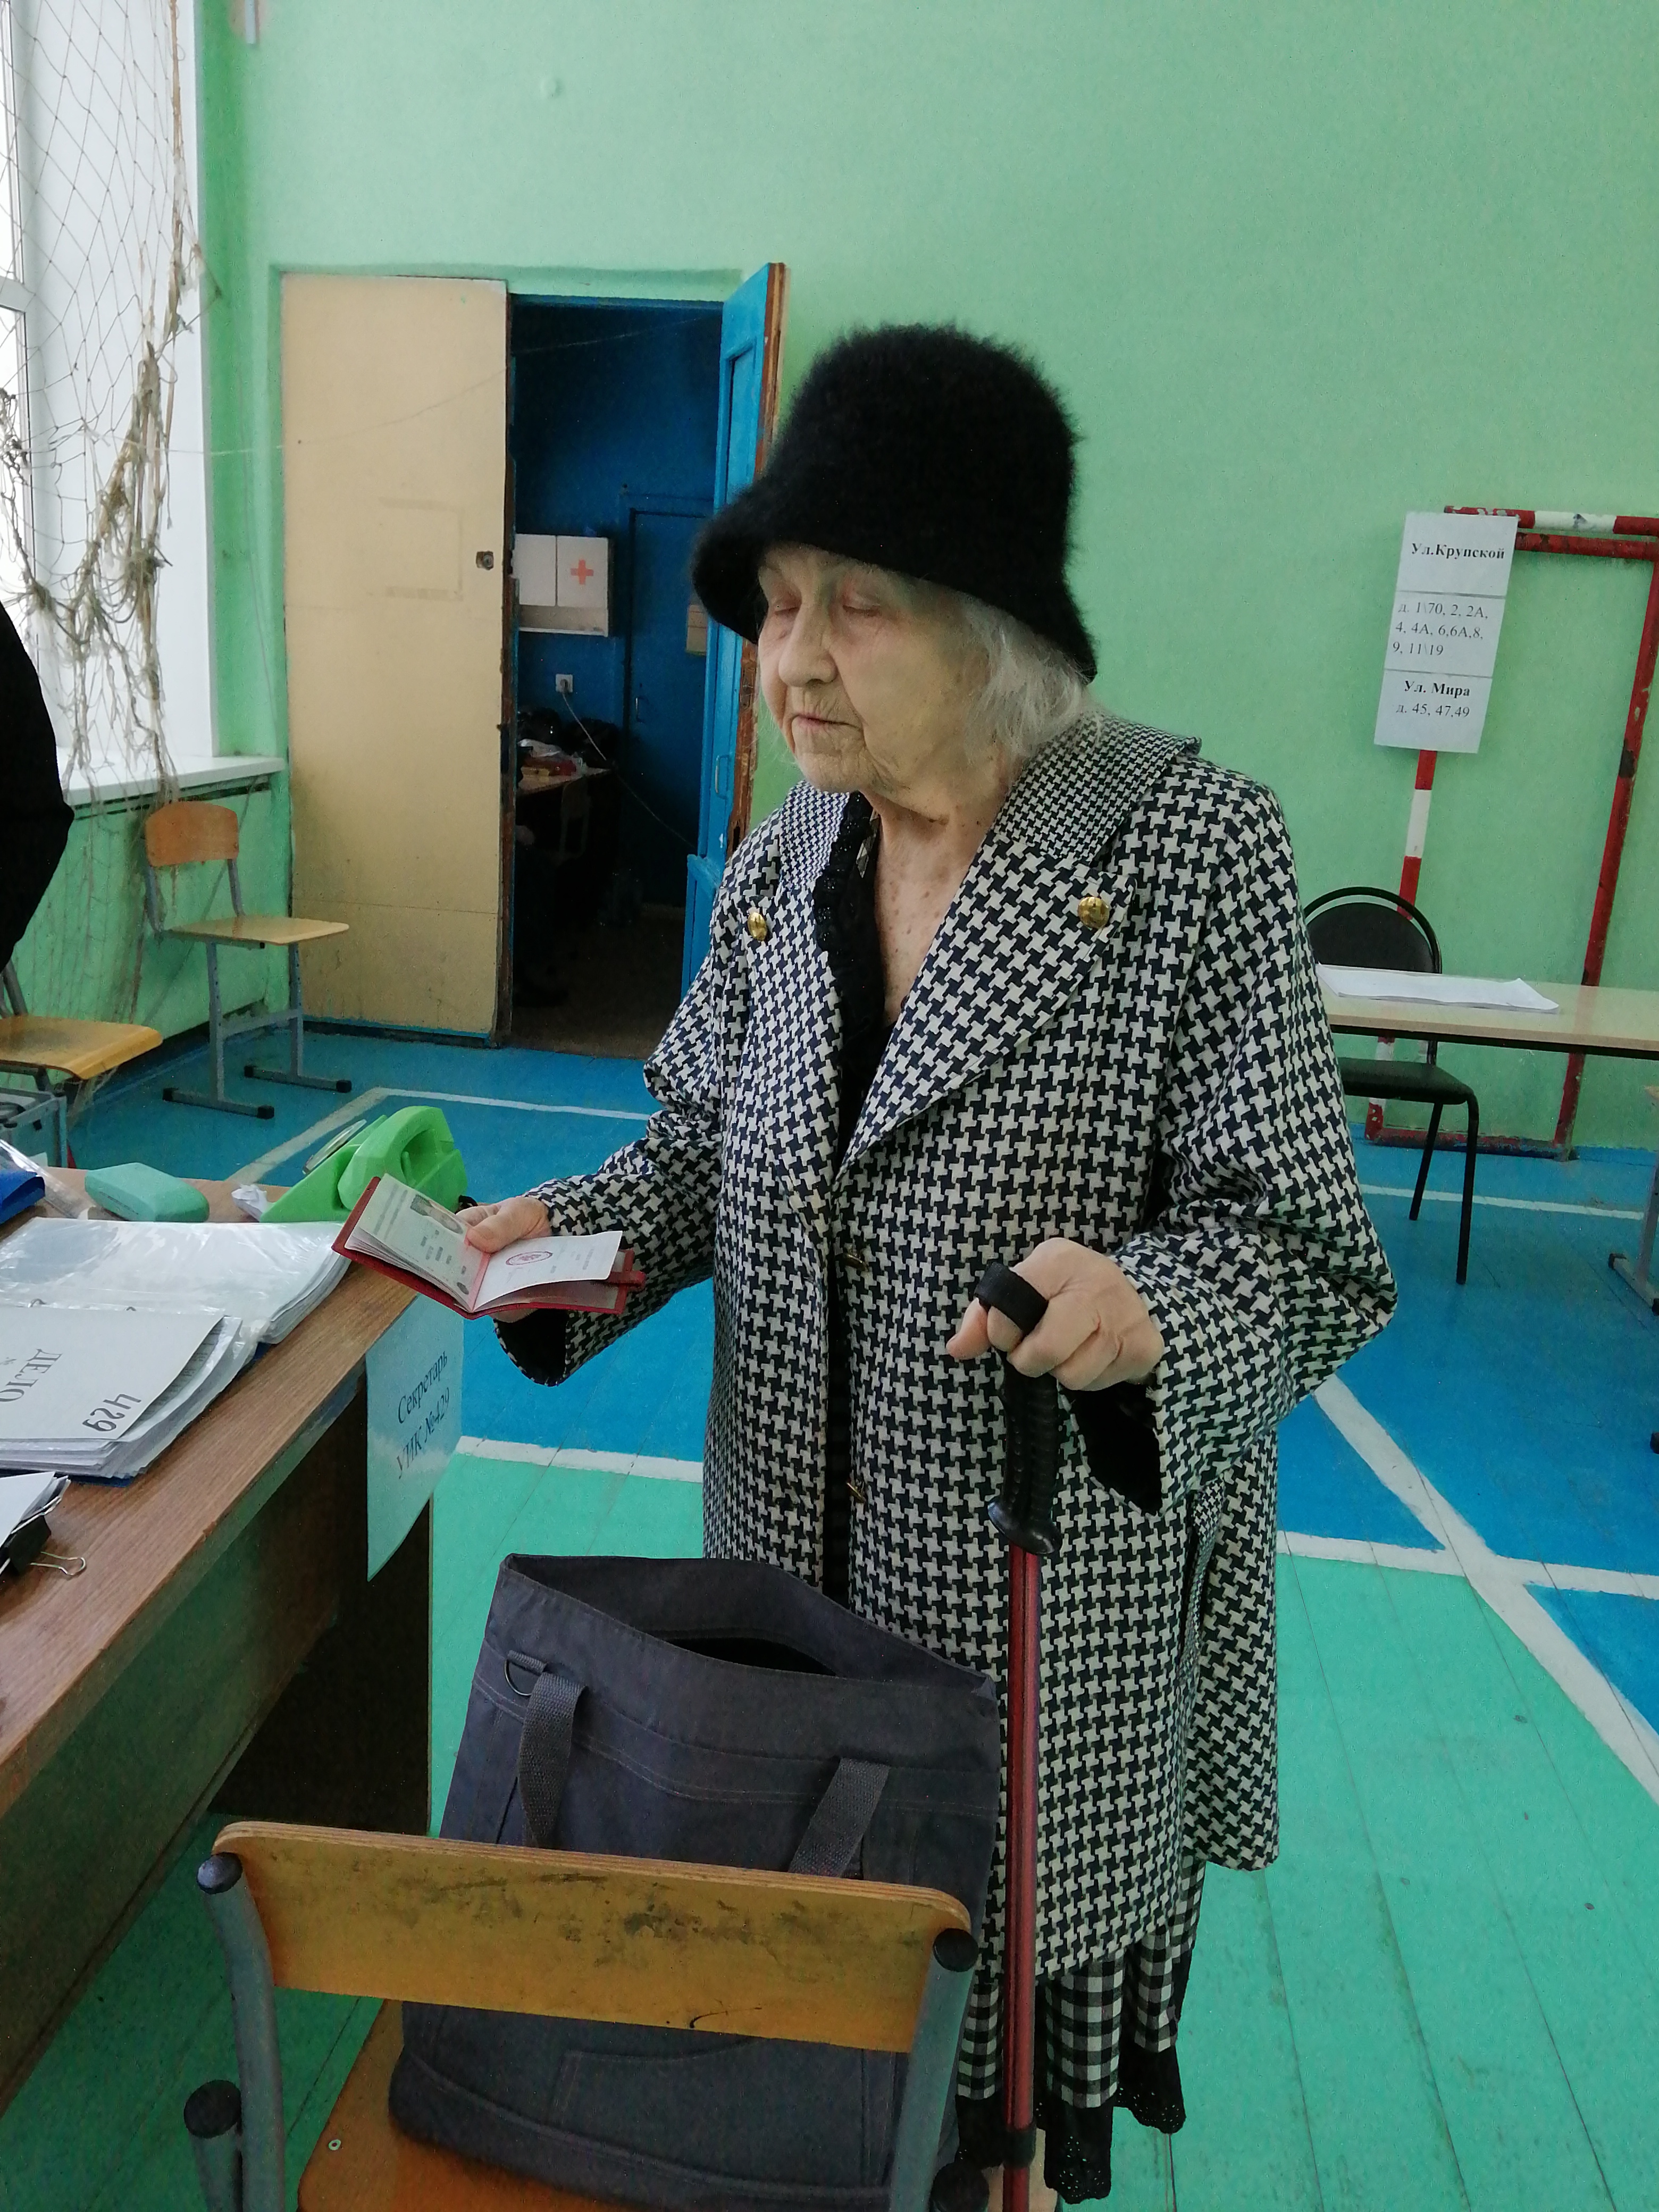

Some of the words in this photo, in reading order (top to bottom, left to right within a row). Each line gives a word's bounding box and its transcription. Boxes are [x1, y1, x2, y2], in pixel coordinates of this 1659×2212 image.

[1393, 641, 1403, 654] 9,
[1404, 681, 1426, 693] Ул.
[1431, 683, 1470, 699] Мира
[1412, 703, 1430, 717] 45,
[0, 1348, 63, 1402] ДЕЛО
[398, 1351, 448, 1424] Секретарь
[82, 1394, 141, 1432] 429
[396, 1425, 422, 1479] УИК
